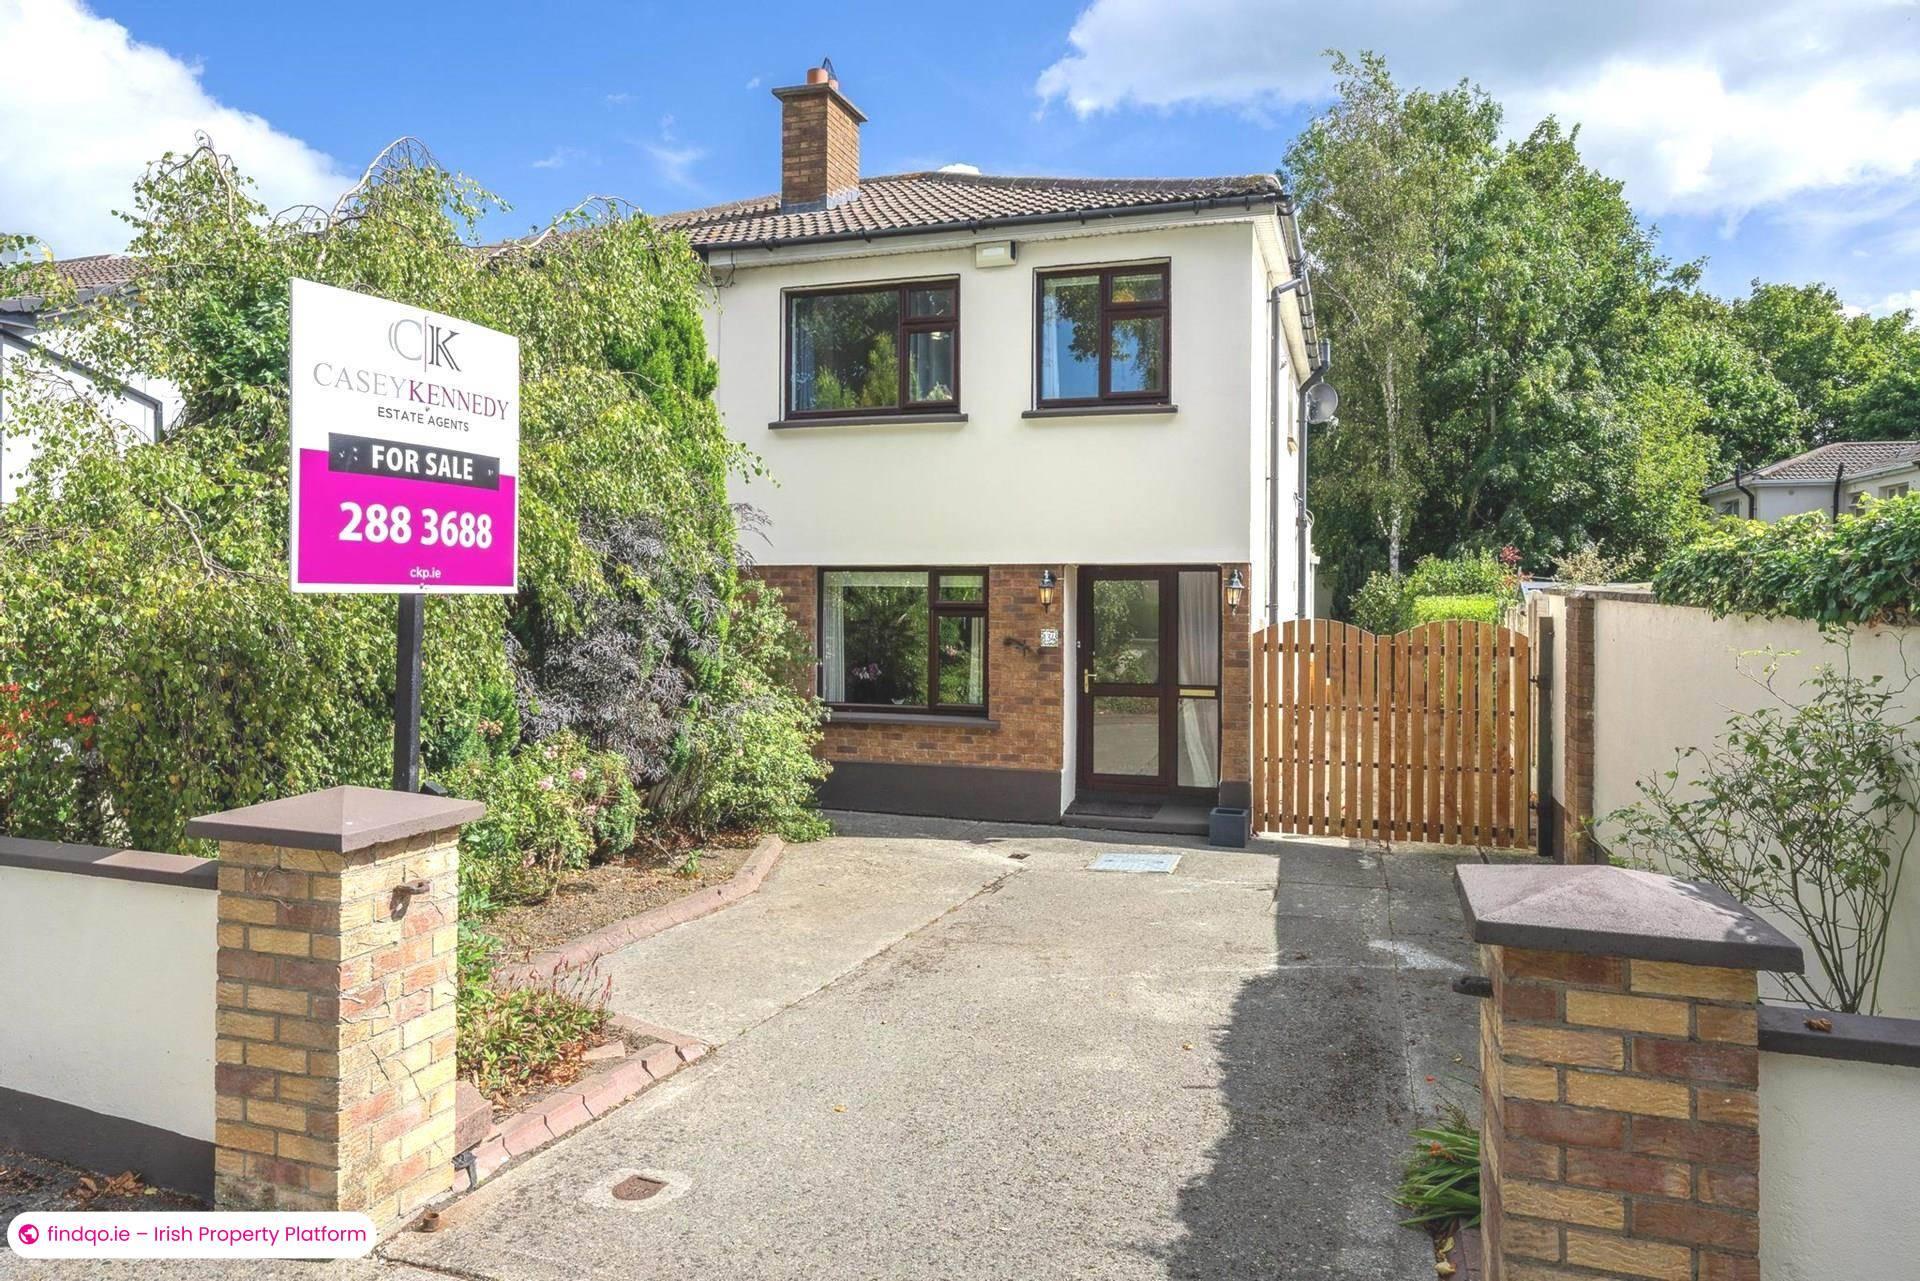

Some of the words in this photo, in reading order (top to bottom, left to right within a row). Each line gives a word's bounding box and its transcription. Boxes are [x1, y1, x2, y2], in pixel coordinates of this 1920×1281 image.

[377, 407, 424, 424] ESTATE
[427, 414, 469, 431] AGENTS
[372, 445, 419, 472] FOR
[425, 457, 473, 480] SALE
[338, 502, 412, 544] 288
[420, 508, 492, 549] 3688
[410, 567, 441, 578] ckp.ie
